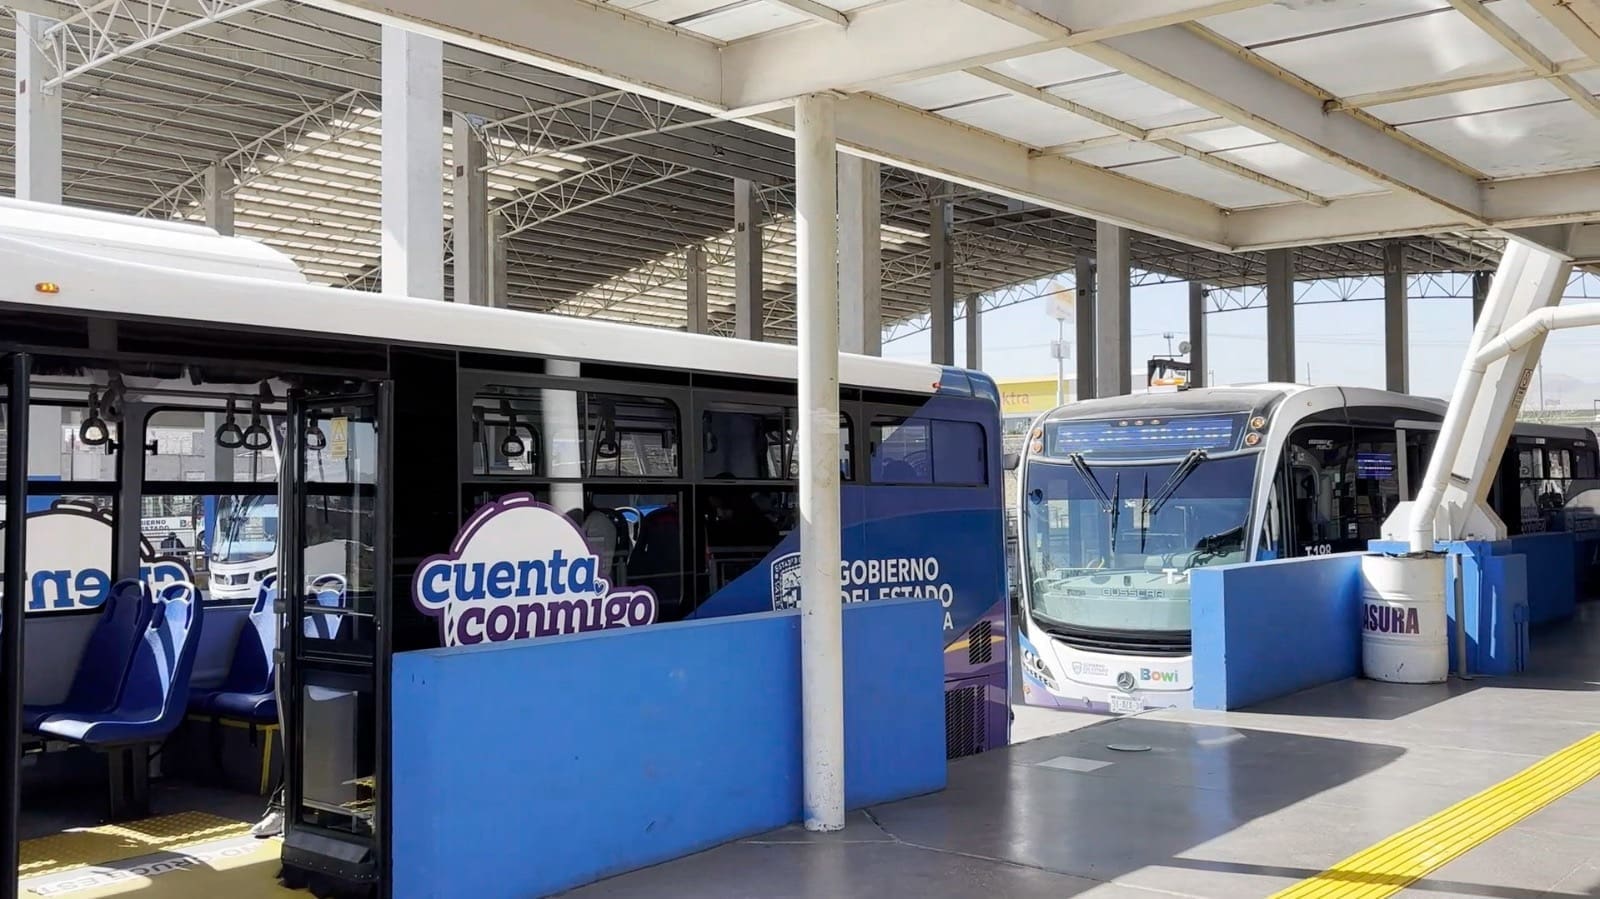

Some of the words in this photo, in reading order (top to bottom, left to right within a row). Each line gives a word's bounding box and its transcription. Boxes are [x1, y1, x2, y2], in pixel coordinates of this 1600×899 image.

[422, 550, 597, 603] cuenta
[841, 557, 939, 586] GOBIERNO
[457, 594, 650, 646] conmigo
[1140, 668, 1178, 682] Bowi
